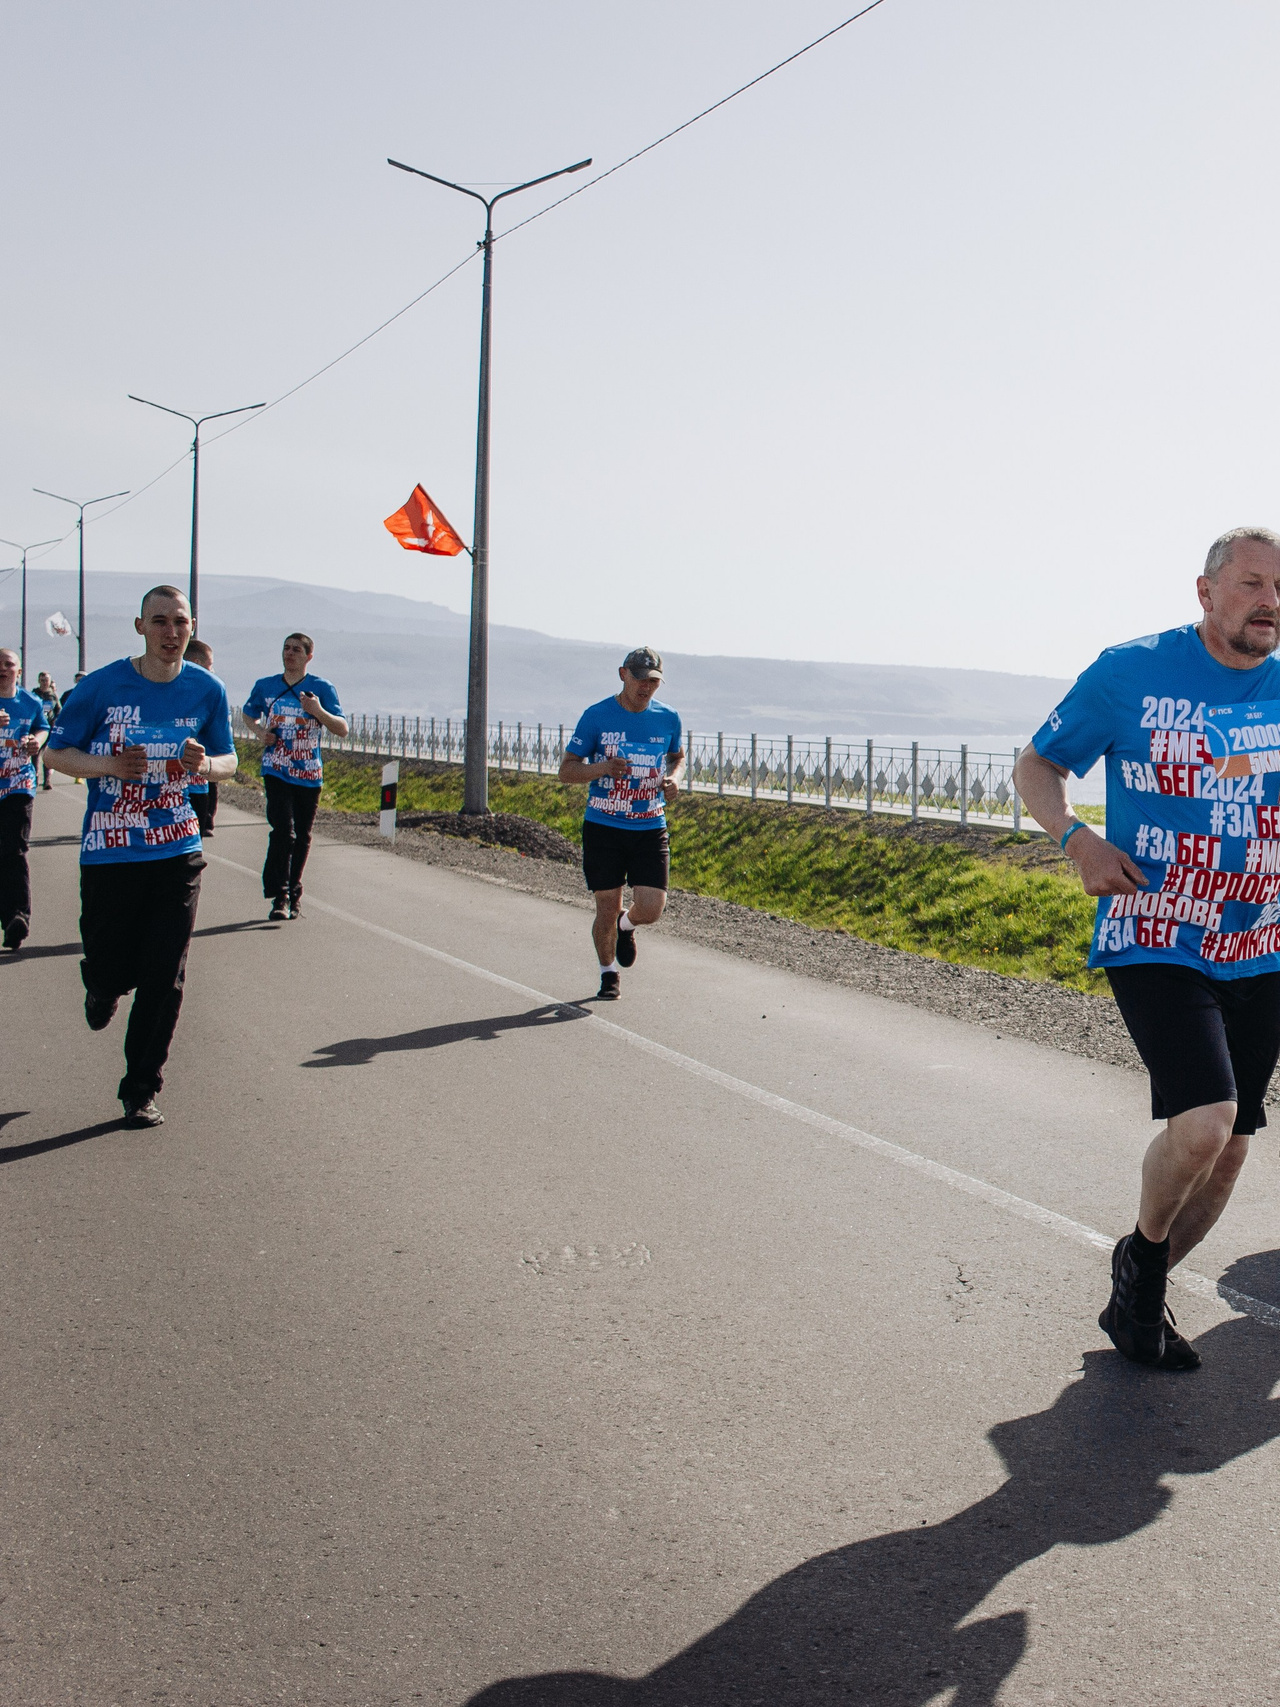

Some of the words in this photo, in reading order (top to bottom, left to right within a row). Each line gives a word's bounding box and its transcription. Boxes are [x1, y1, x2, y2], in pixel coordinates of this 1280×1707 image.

[105, 705, 141, 724] 2024
[1140, 696, 1206, 732] 2024
[1218, 708, 1233, 716] ПСБ
[601, 732, 626, 744] 2024
[98, 776, 147, 801] #ЗАБЕГ
[598, 778, 631, 790] #ЗАБЕГ
[1135, 823, 1222, 870] #ЗАБЕГ
[1097, 916, 1180, 952] #ЗАБЕГ
